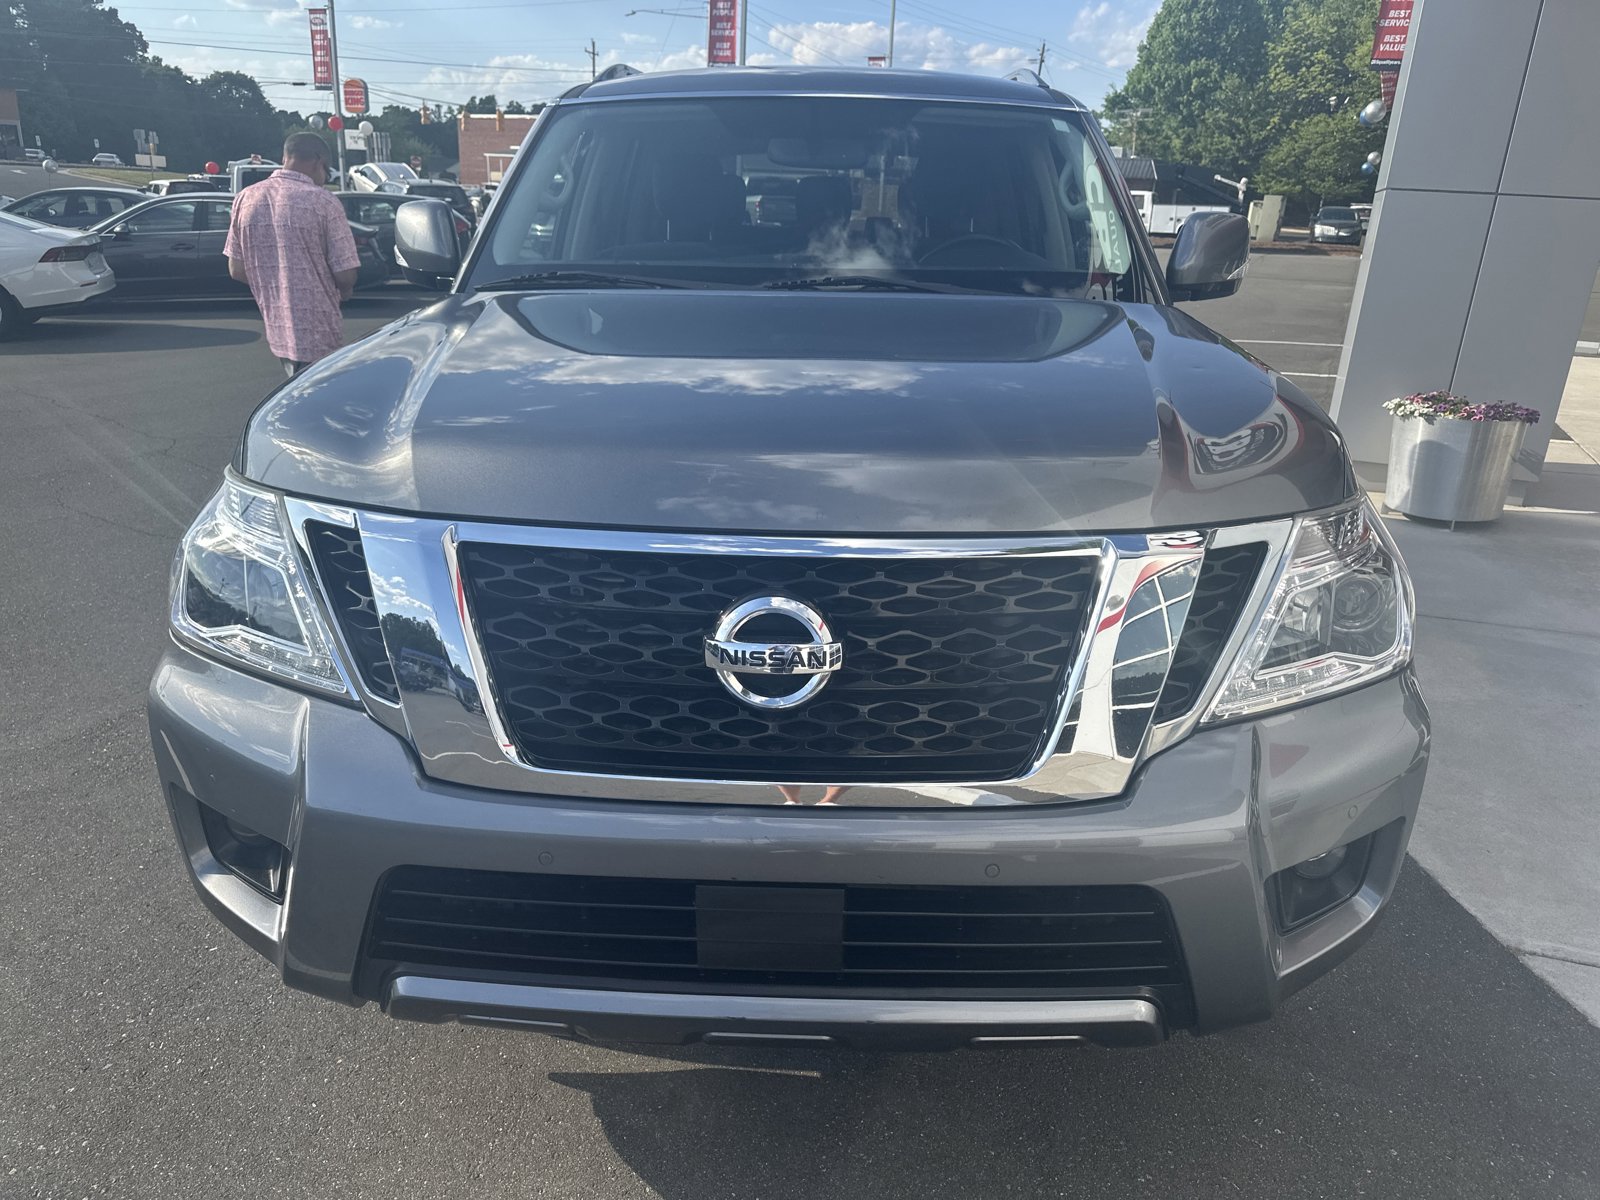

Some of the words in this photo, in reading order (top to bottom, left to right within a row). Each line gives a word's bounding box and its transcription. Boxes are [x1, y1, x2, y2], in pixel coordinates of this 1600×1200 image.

[1379, 19, 1410, 27] SERVIC
[1383, 34, 1406, 42] BEST
[1379, 43, 1406, 51] VALUE
[719, 648, 827, 668] NISSAN
